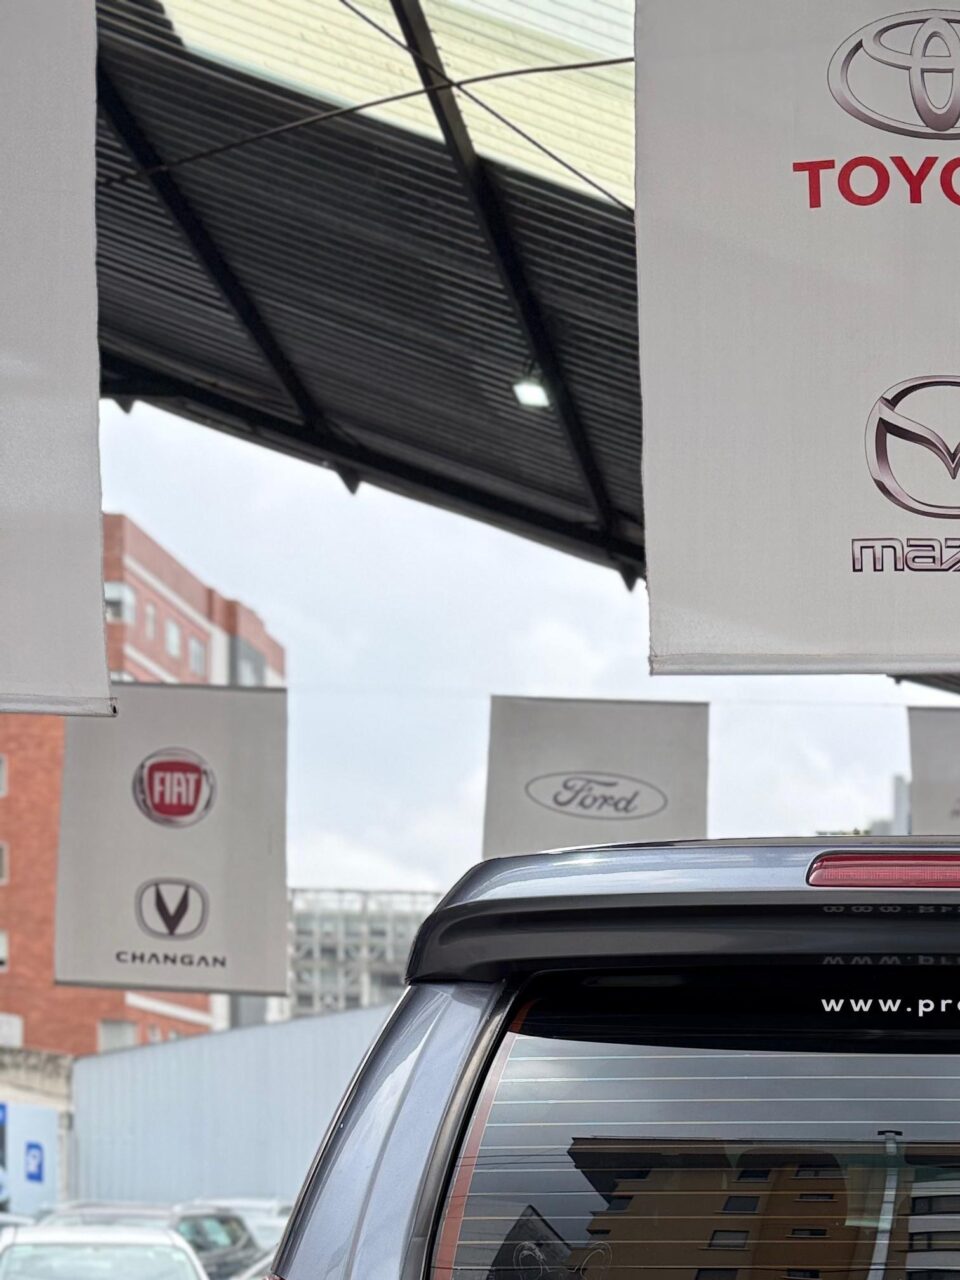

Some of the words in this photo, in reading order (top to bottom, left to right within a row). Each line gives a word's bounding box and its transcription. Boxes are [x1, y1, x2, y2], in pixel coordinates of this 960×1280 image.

[153, 771, 199, 805] FIAT
[552, 776, 640, 813] Ford
[115, 950, 227, 968] CHANGAN
